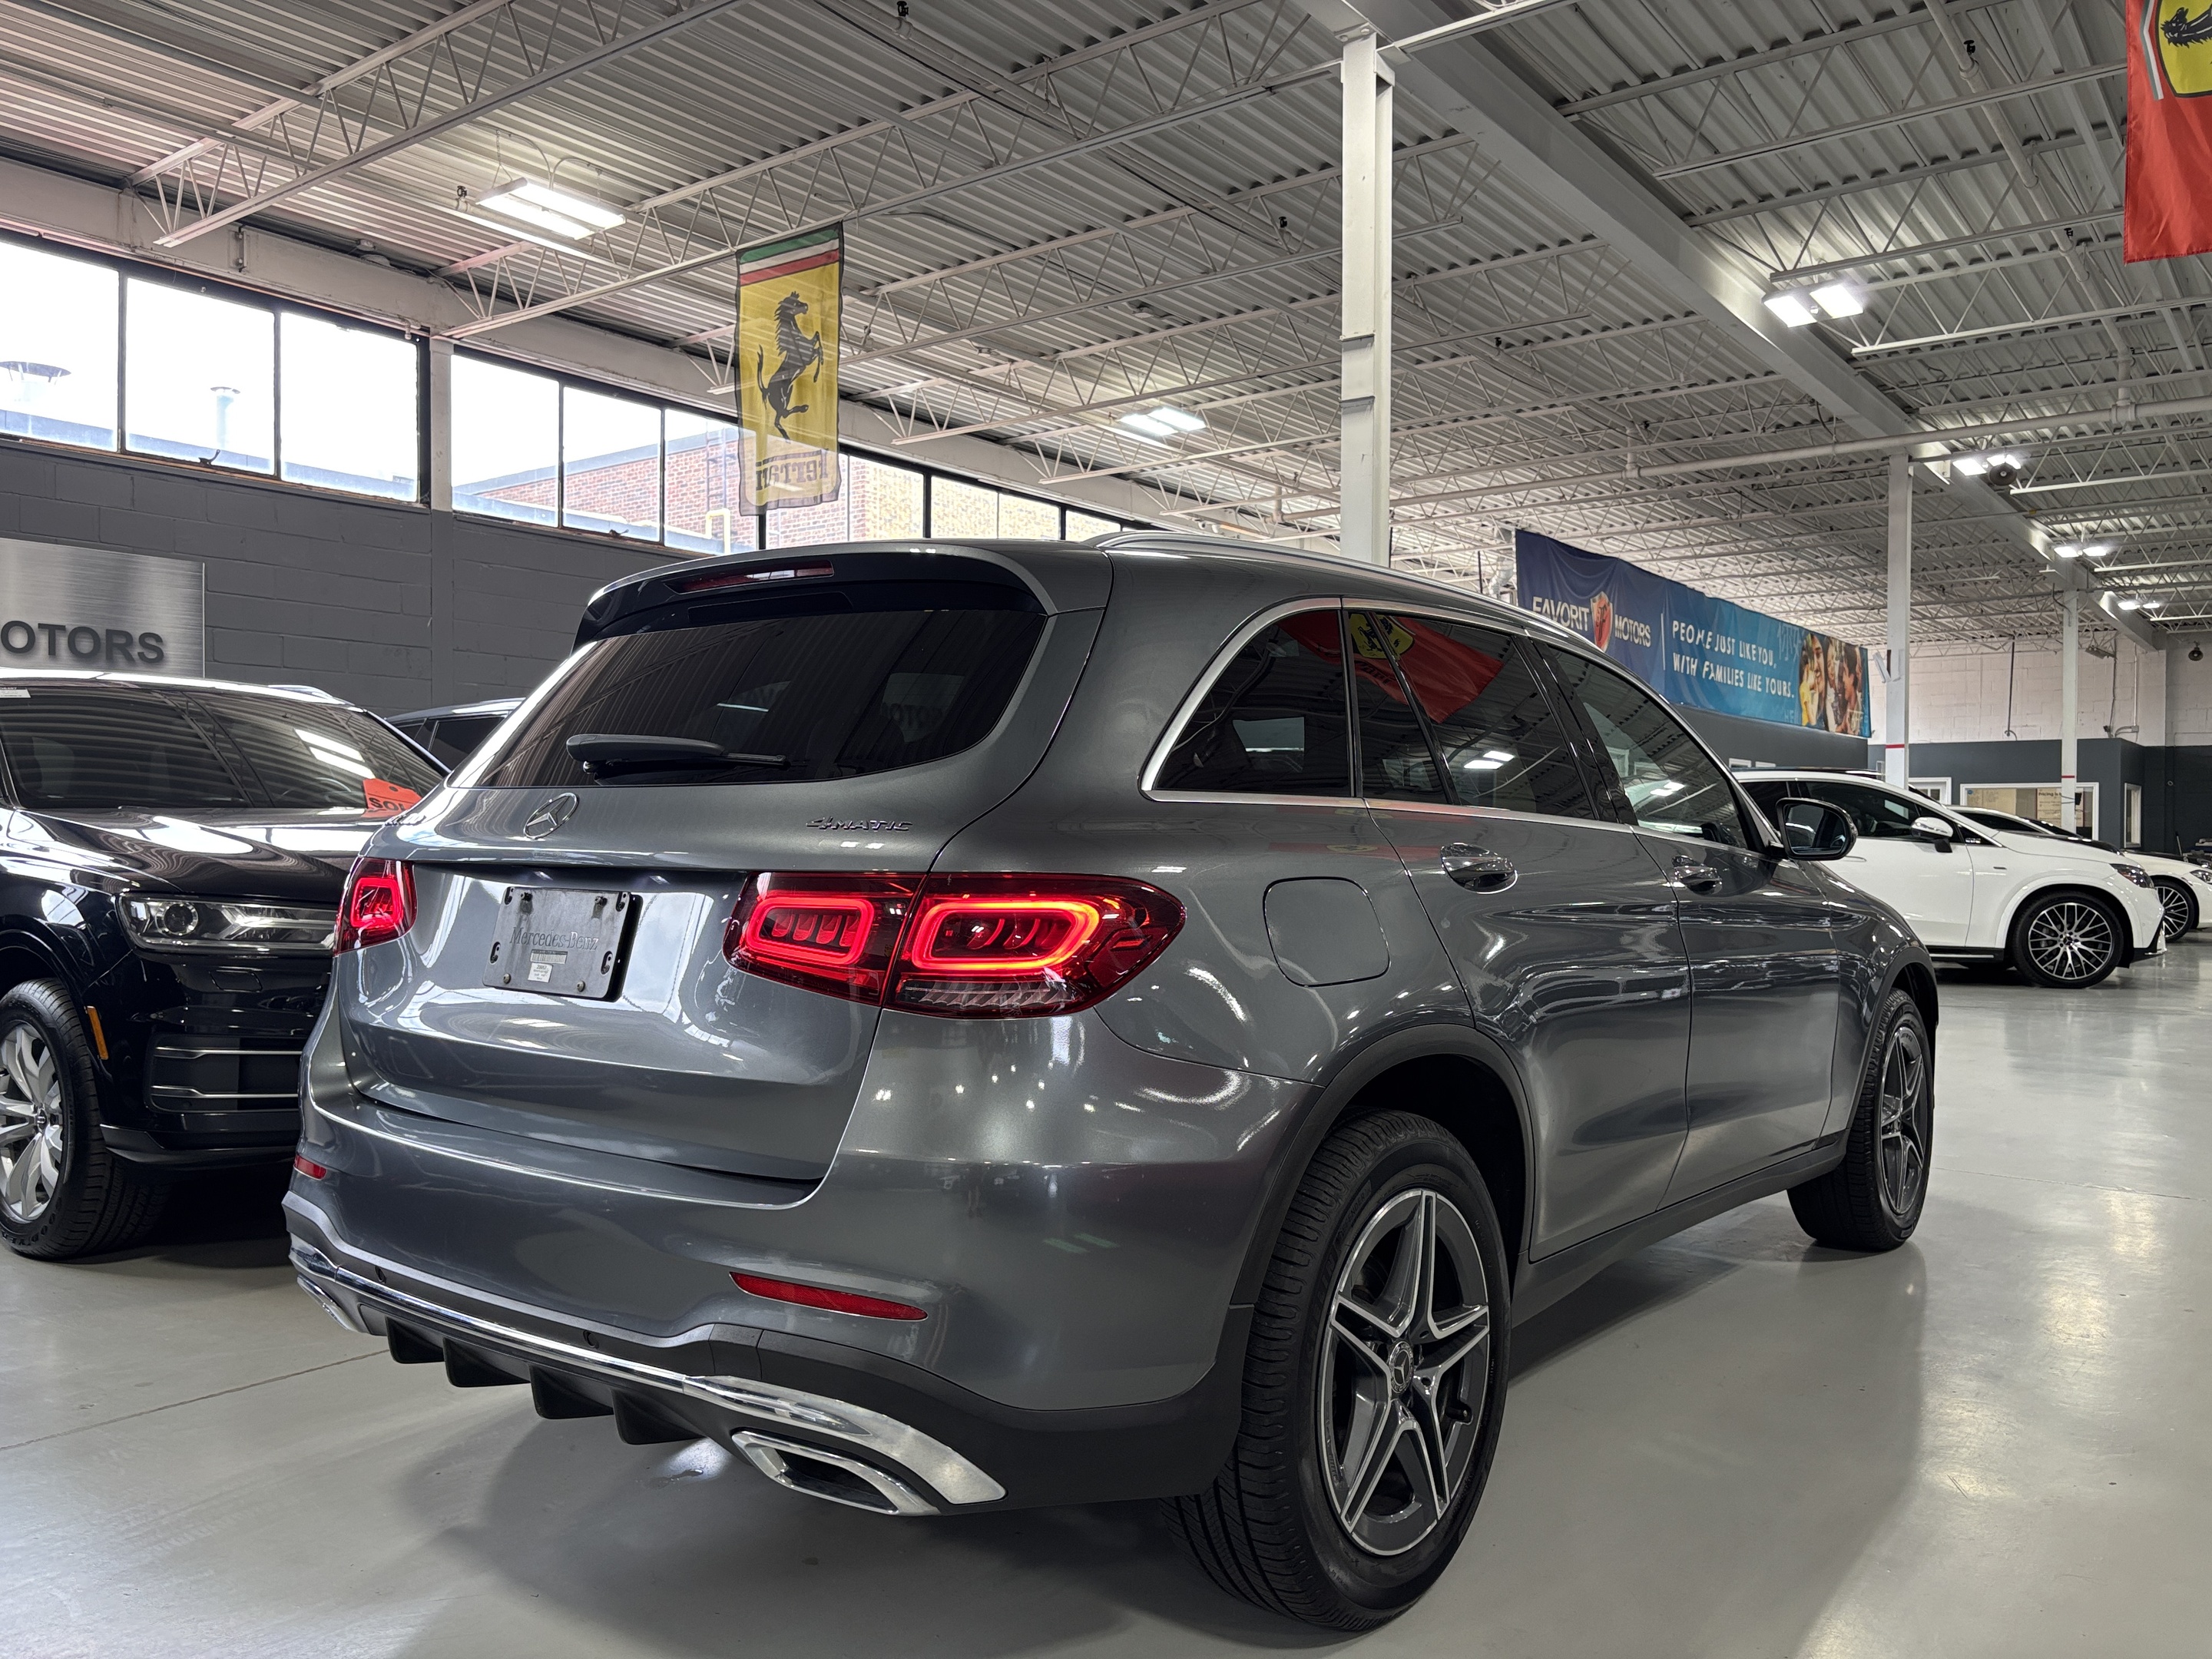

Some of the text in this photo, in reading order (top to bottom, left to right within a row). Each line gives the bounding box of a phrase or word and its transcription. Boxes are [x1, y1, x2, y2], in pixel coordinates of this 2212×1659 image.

[1533, 597, 1590, 631] FAVORIT
[1614, 614, 1651, 647] MOTORS
[1, 620, 164, 664] OTORS
[1714, 634, 1736, 656] JUST
[1739, 641, 1757, 661] LIKE
[1673, 652, 1795, 699] WITH FAMILIES LIKE YOURS.
[806, 816, 912, 832] 4MATIC
[509, 926, 599, 951] Mercedes-Benz
